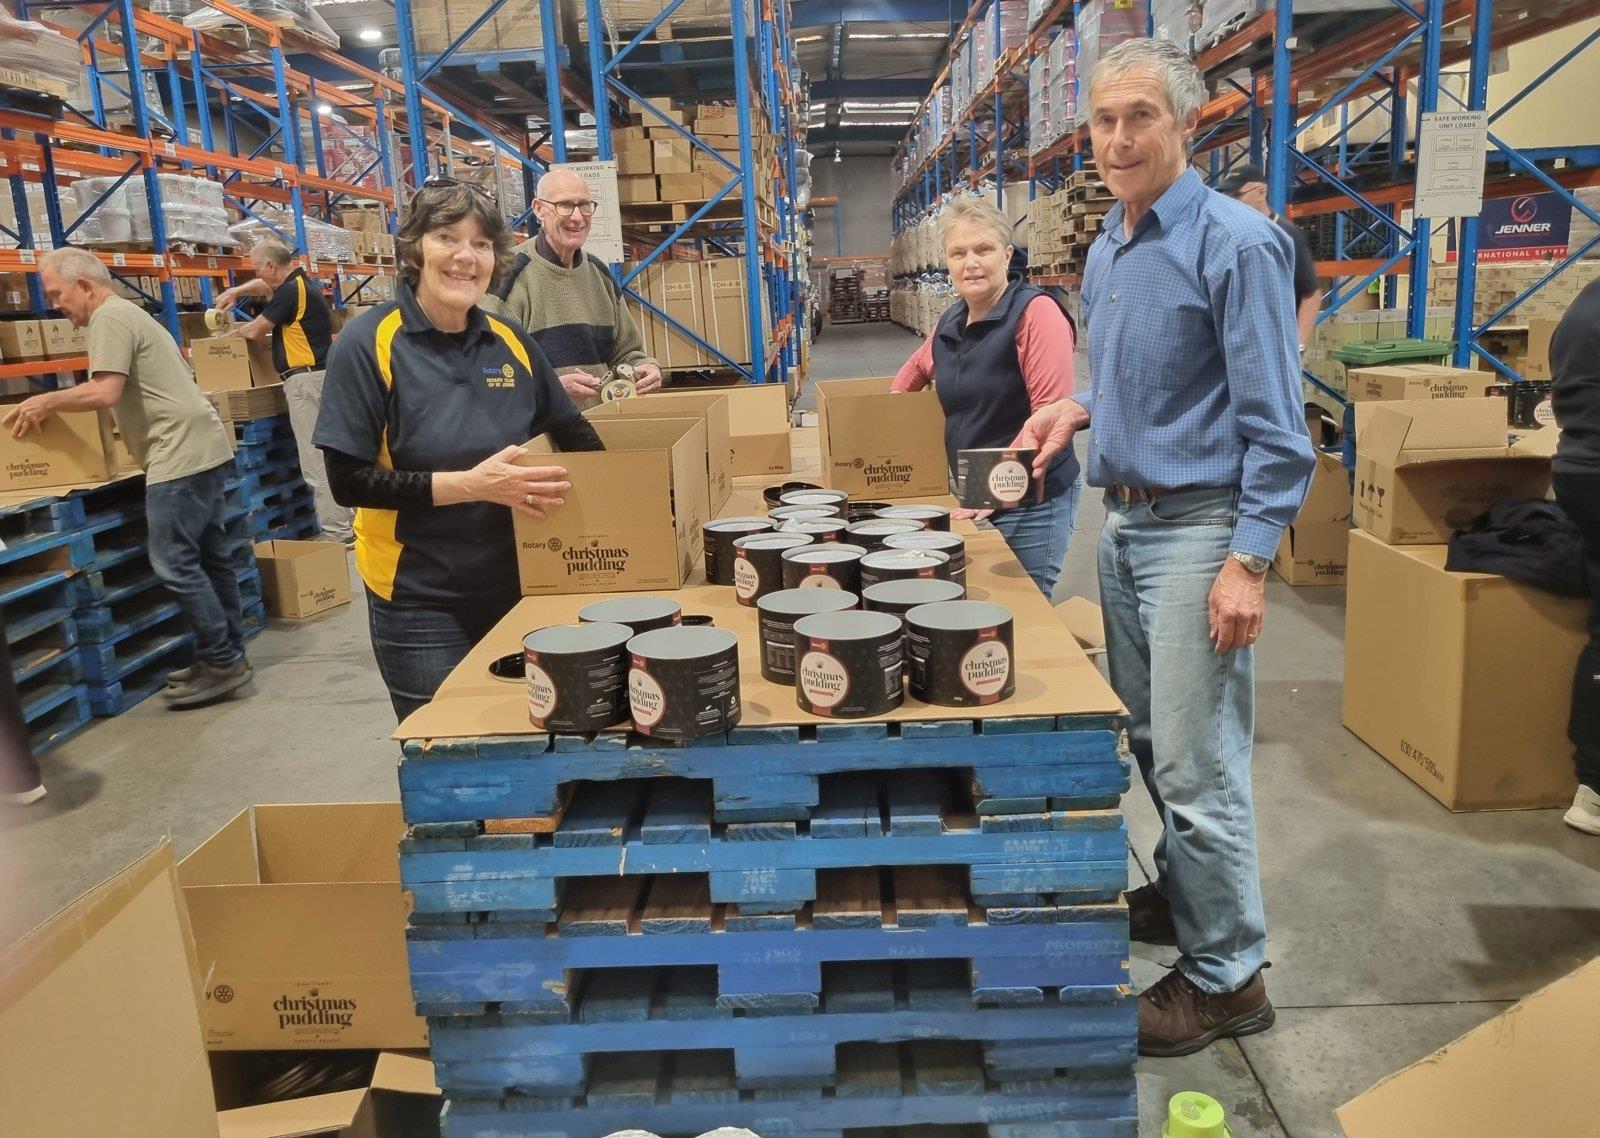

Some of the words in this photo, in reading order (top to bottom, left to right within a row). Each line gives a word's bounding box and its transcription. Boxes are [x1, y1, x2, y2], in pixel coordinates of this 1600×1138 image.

[575, 164, 605, 172] WORKING
[1494, 222, 1552, 235] JENNER
[1477, 250, 1531, 259] RNATIONAL
[482, 366, 502, 375] Rotary
[1429, 382, 1469, 393] christmas
[1431, 389, 1466, 399] pudding
[5, 461, 51, 472] christmas
[863, 463, 914, 475] christmas
[866, 471, 912, 486] pudding
[991, 473, 1027, 483] christmas
[993, 480, 1025, 490] pudding
[522, 541, 547, 550] Rotary
[561, 547, 630, 561] christmas
[566, 557, 627, 576] pudding
[964, 656, 1008, 672] christmas
[801, 666, 845, 681] christmas
[967, 665, 1006, 682] pudding
[803, 676, 842, 692] pudding
[273, 995, 357, 1012] christmas
[278, 1006, 354, 1030] pudding
